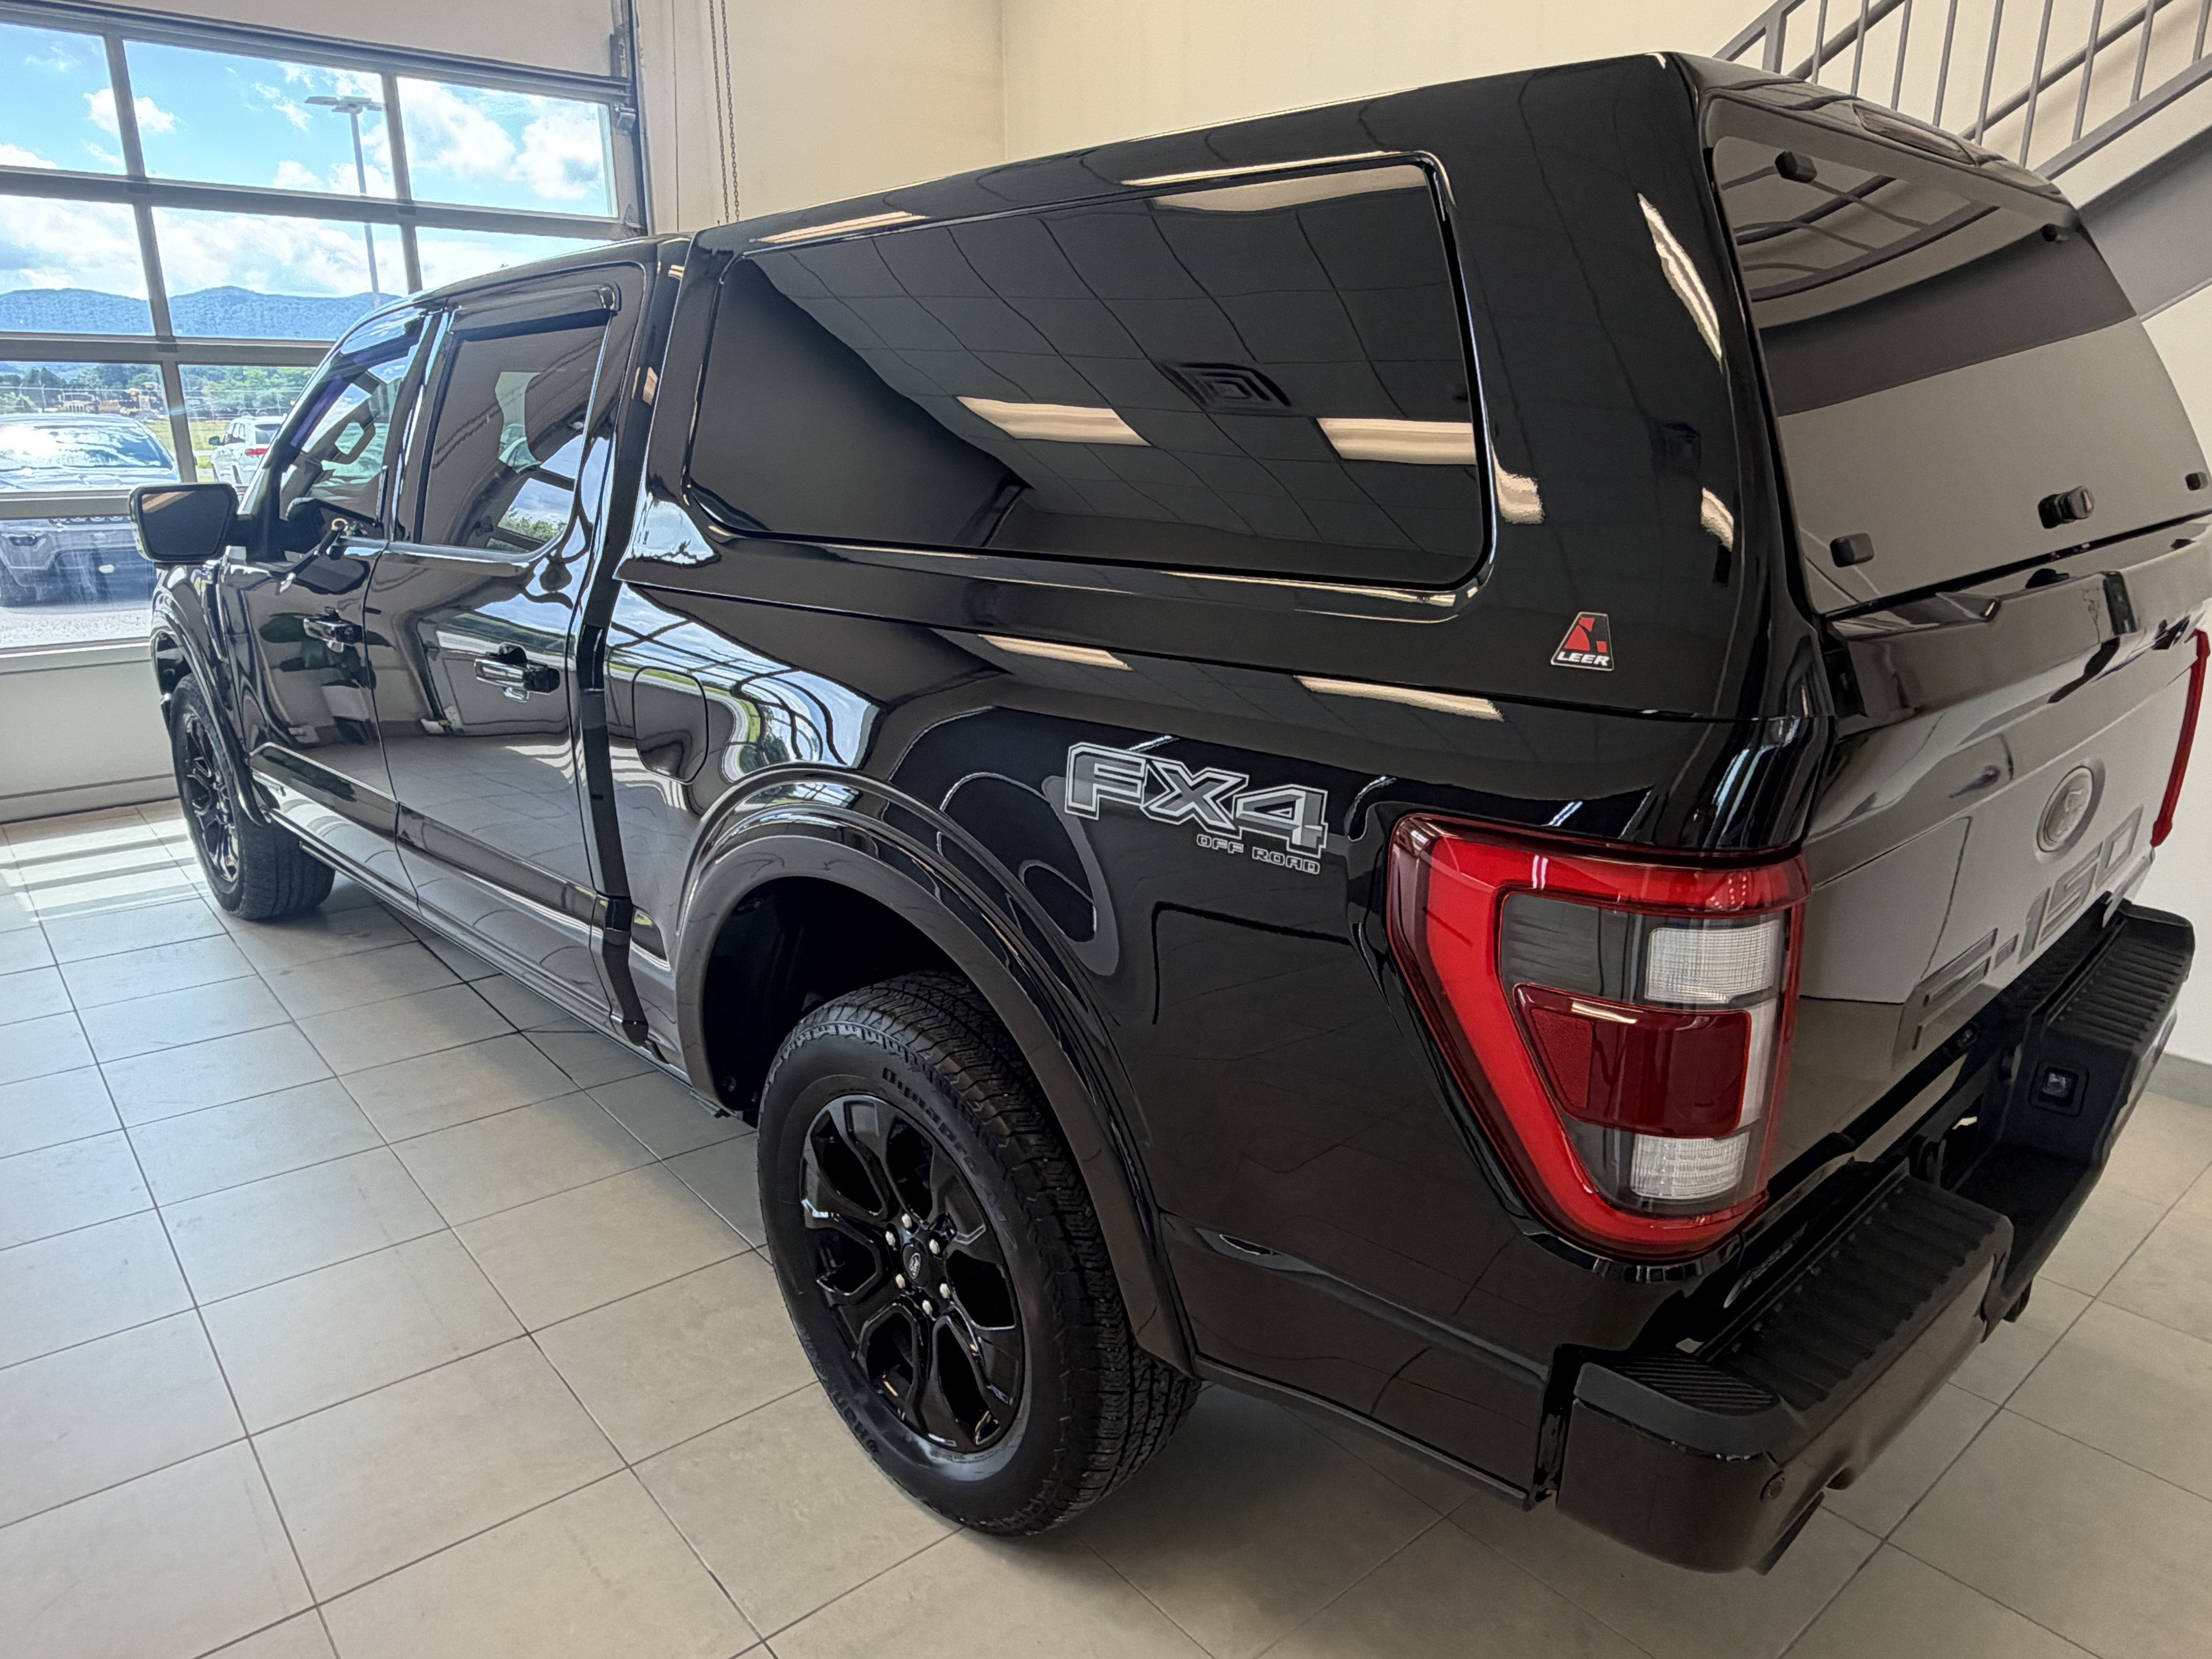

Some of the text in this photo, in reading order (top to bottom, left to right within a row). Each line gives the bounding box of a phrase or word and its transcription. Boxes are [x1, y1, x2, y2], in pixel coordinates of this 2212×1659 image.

[1556, 651, 1610, 666] LEER
[1065, 742, 1328, 859] FX4
[1196, 833, 1320, 874] OFF ROAD
